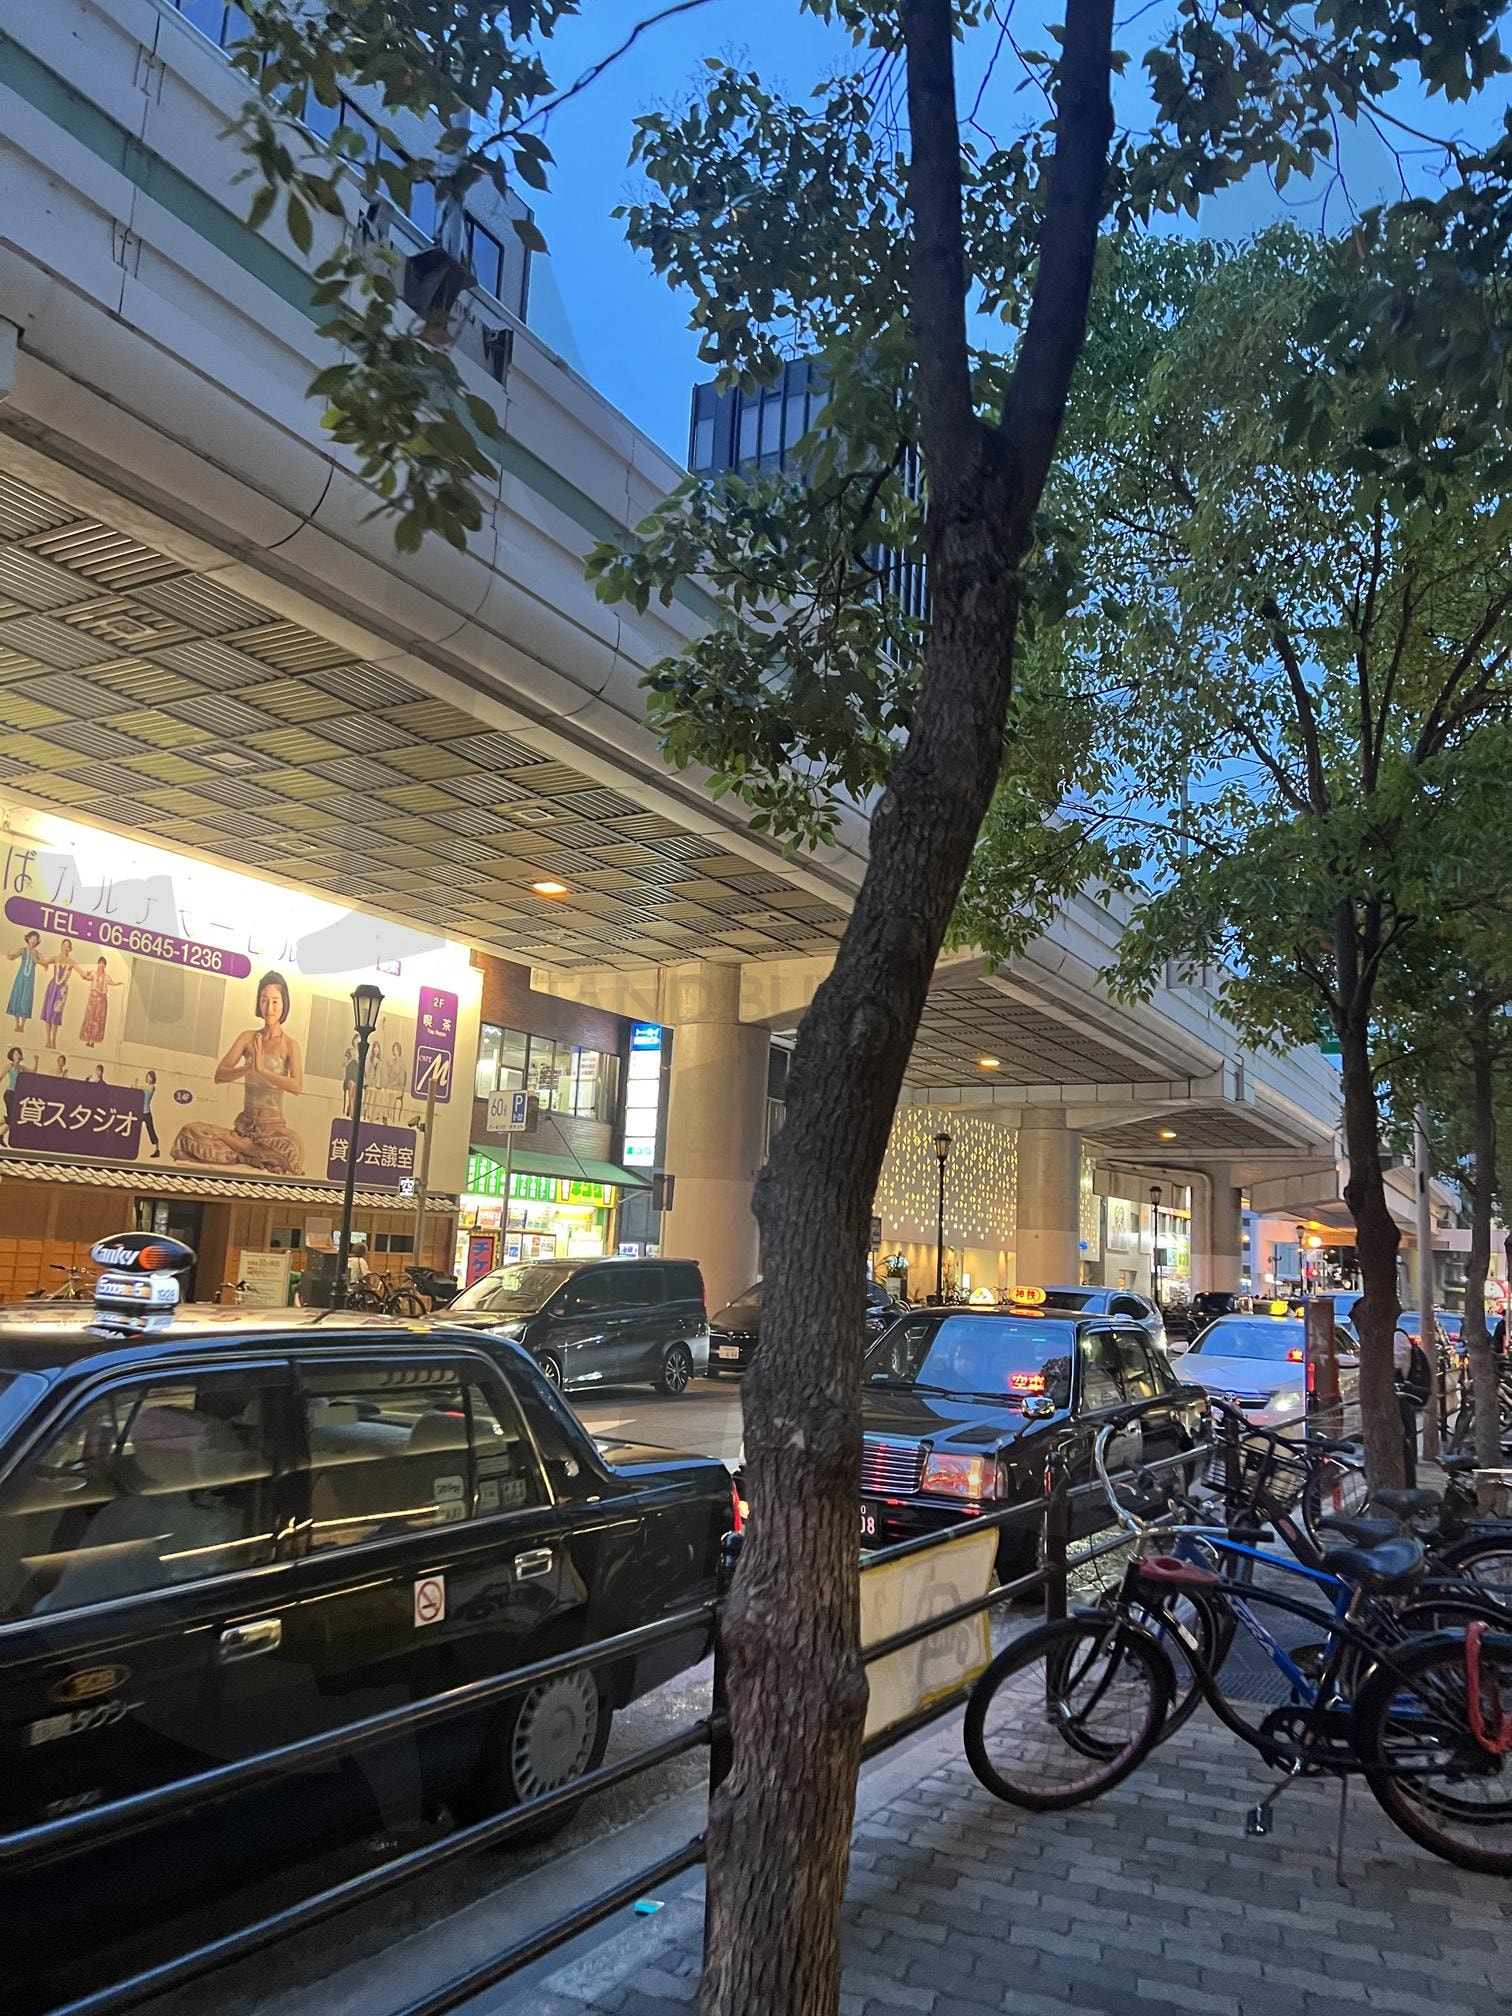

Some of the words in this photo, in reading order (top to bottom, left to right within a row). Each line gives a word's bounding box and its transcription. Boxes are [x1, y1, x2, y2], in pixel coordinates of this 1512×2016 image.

[99, 922, 222, 970] 06-6645-1236
[433, 997, 445, 1008] 2F
[17, 1096, 138, 1137] 貸スタジオ
[515, 1095, 523, 1112] P
